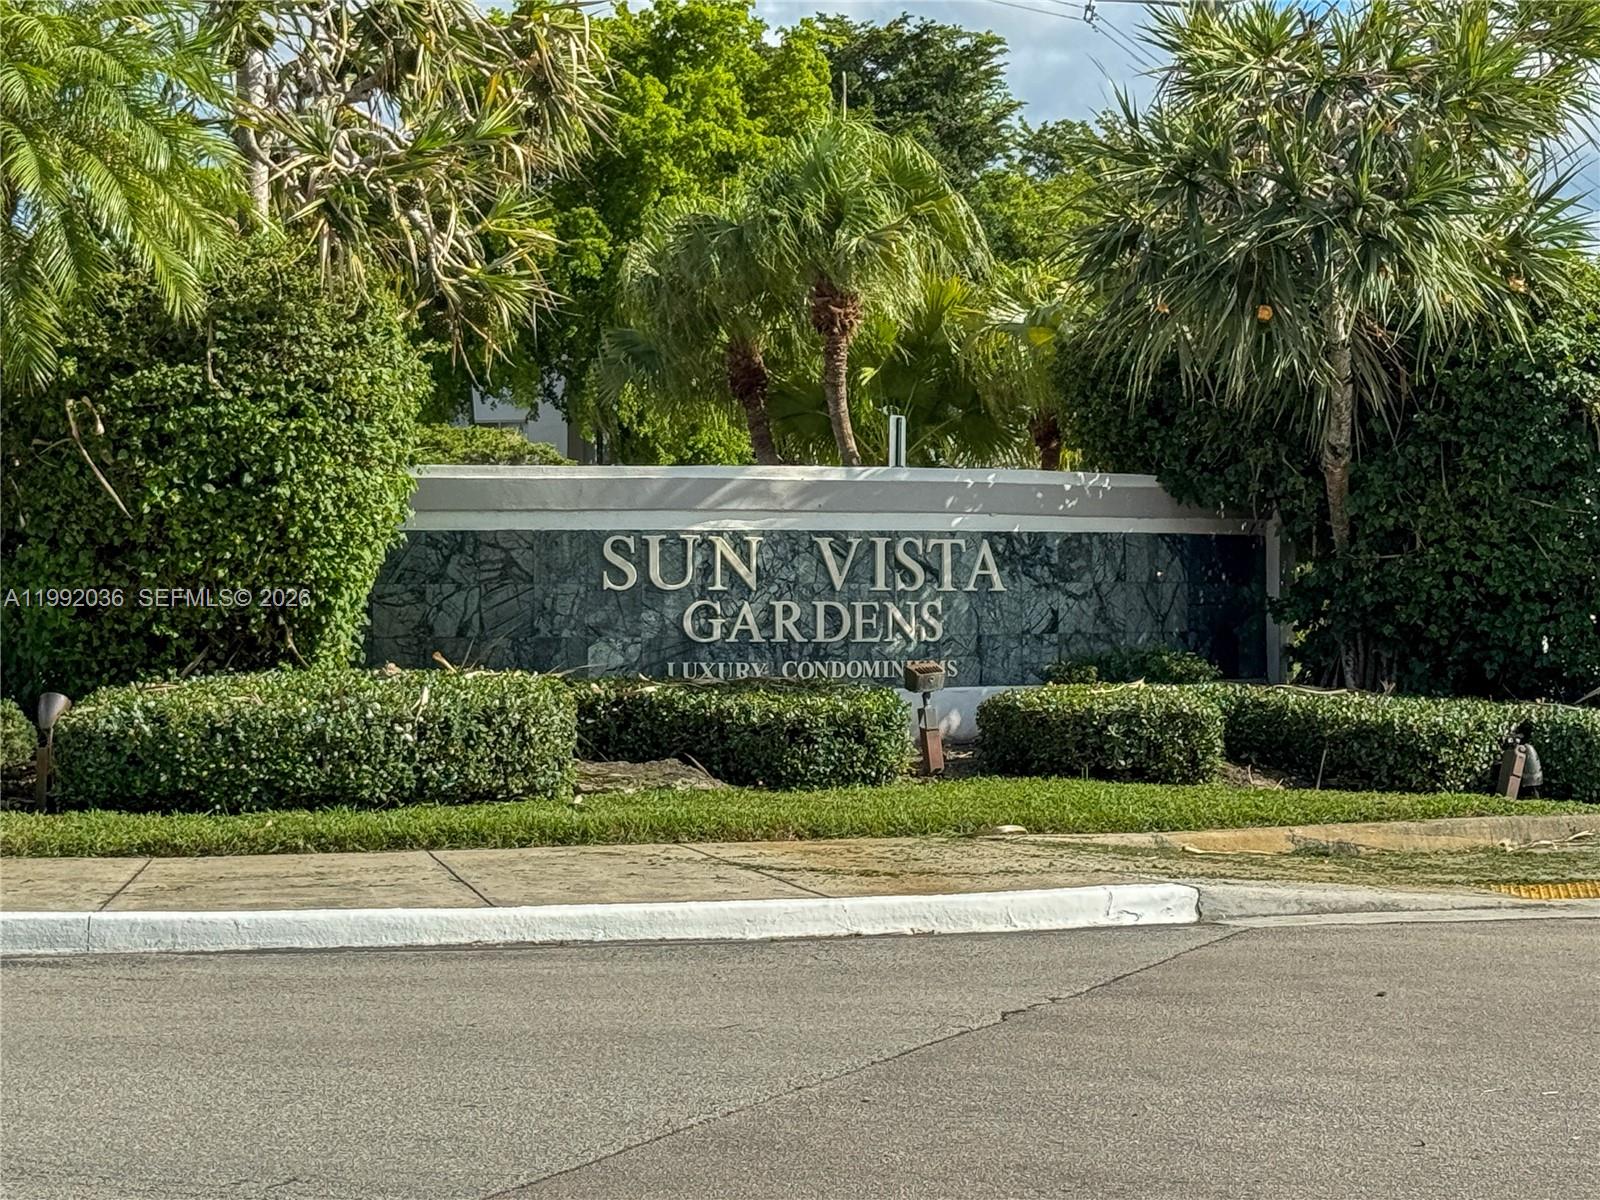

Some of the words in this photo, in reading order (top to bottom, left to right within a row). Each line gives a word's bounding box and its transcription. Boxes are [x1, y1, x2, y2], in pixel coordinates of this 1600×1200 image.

[602, 534, 762, 592] SUN
[812, 536, 1008, 592] VISTA
[682, 599, 943, 644] GARDENS
[781, 659, 959, 680] CONDOMINS
